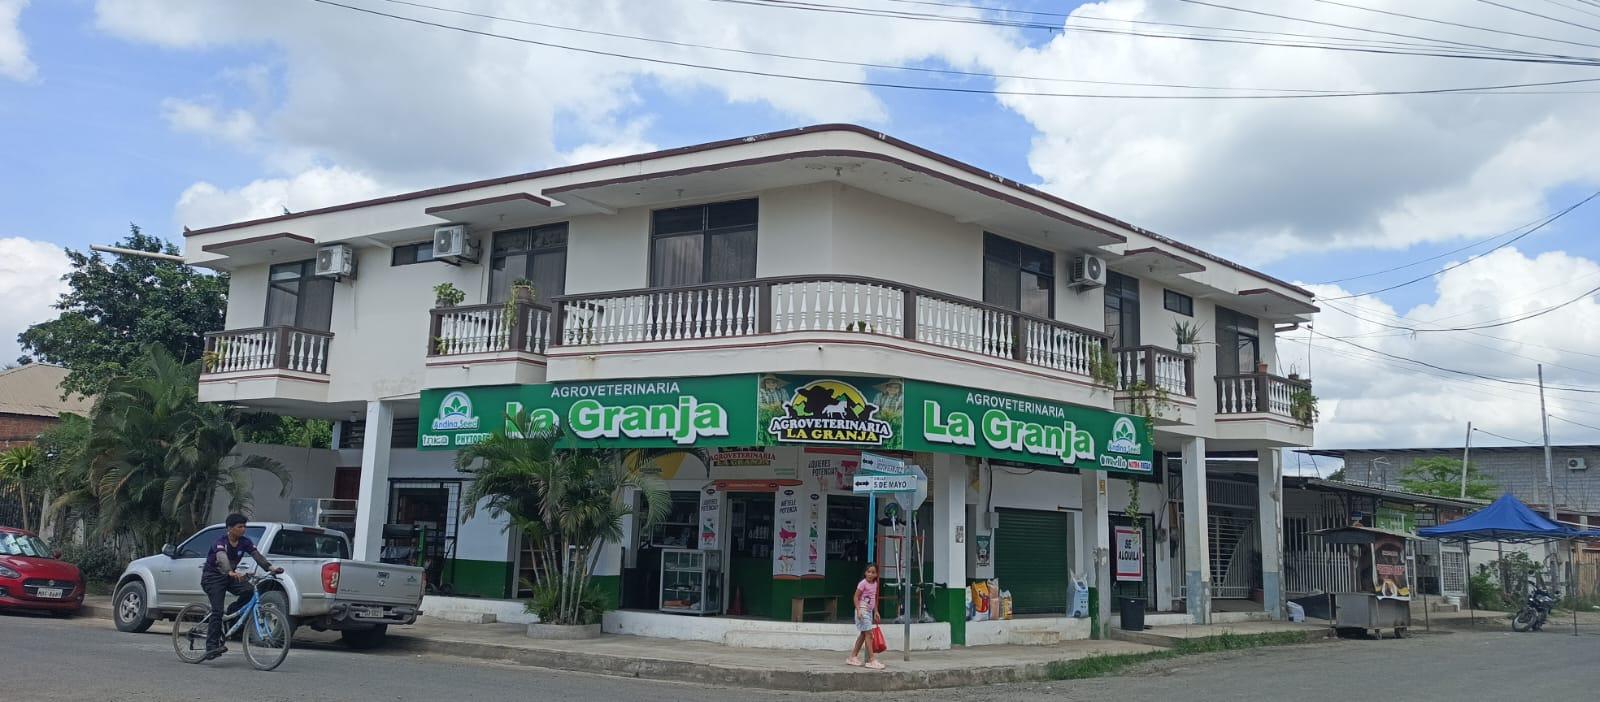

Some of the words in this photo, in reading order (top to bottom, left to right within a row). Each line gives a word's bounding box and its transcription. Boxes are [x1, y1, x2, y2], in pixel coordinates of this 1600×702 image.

[551, 382, 680, 398] AGROVETERINARIA
[966, 392, 1065, 419] AGROVETERINARIA
[505, 401, 560, 439] La
[568, 396, 729, 444] Granja
[772, 418, 889, 435] AGROVETERINARIA
[786, 428, 808, 439] LA
[811, 429, 878, 441] GRANJA
[923, 400, 976, 446] La
[982, 409, 1096, 464] Granja
[710, 452, 776, 461] AGROVETERINARIA
[879, 481, 888, 489] DE
[888, 481, 907, 489] MAYO
[1124, 539, 1132, 549] SE
[1118, 550, 1139, 561] ALQUILA
